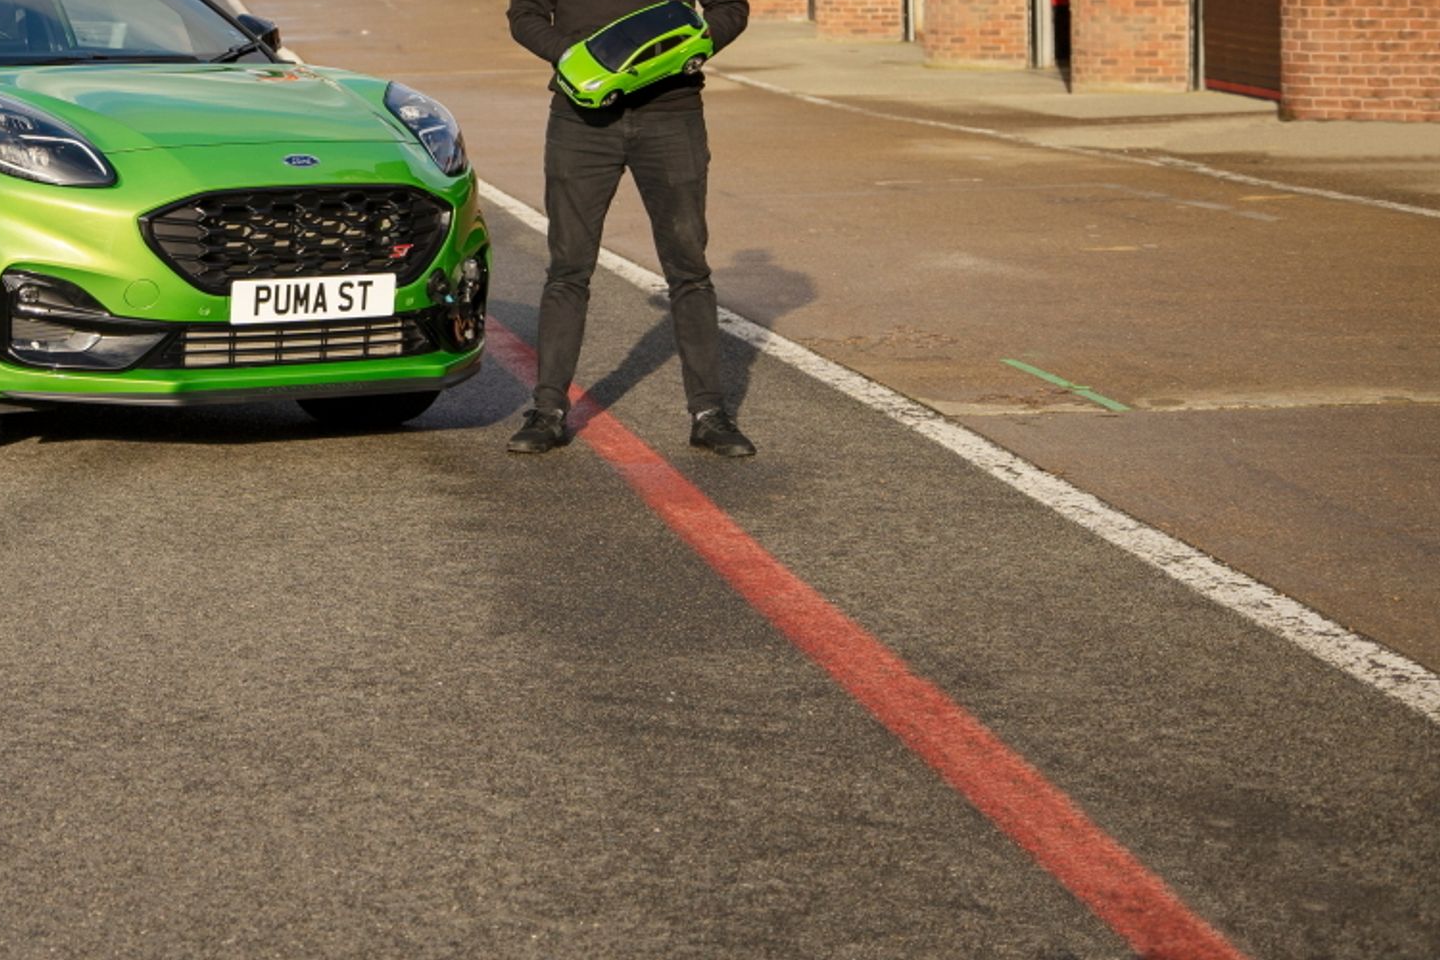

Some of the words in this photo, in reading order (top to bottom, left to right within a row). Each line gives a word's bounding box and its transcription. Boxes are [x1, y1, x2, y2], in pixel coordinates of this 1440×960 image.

[389, 243, 414, 258] ST
[253, 282, 328, 316] PUMA
[337, 280, 374, 312] ST
